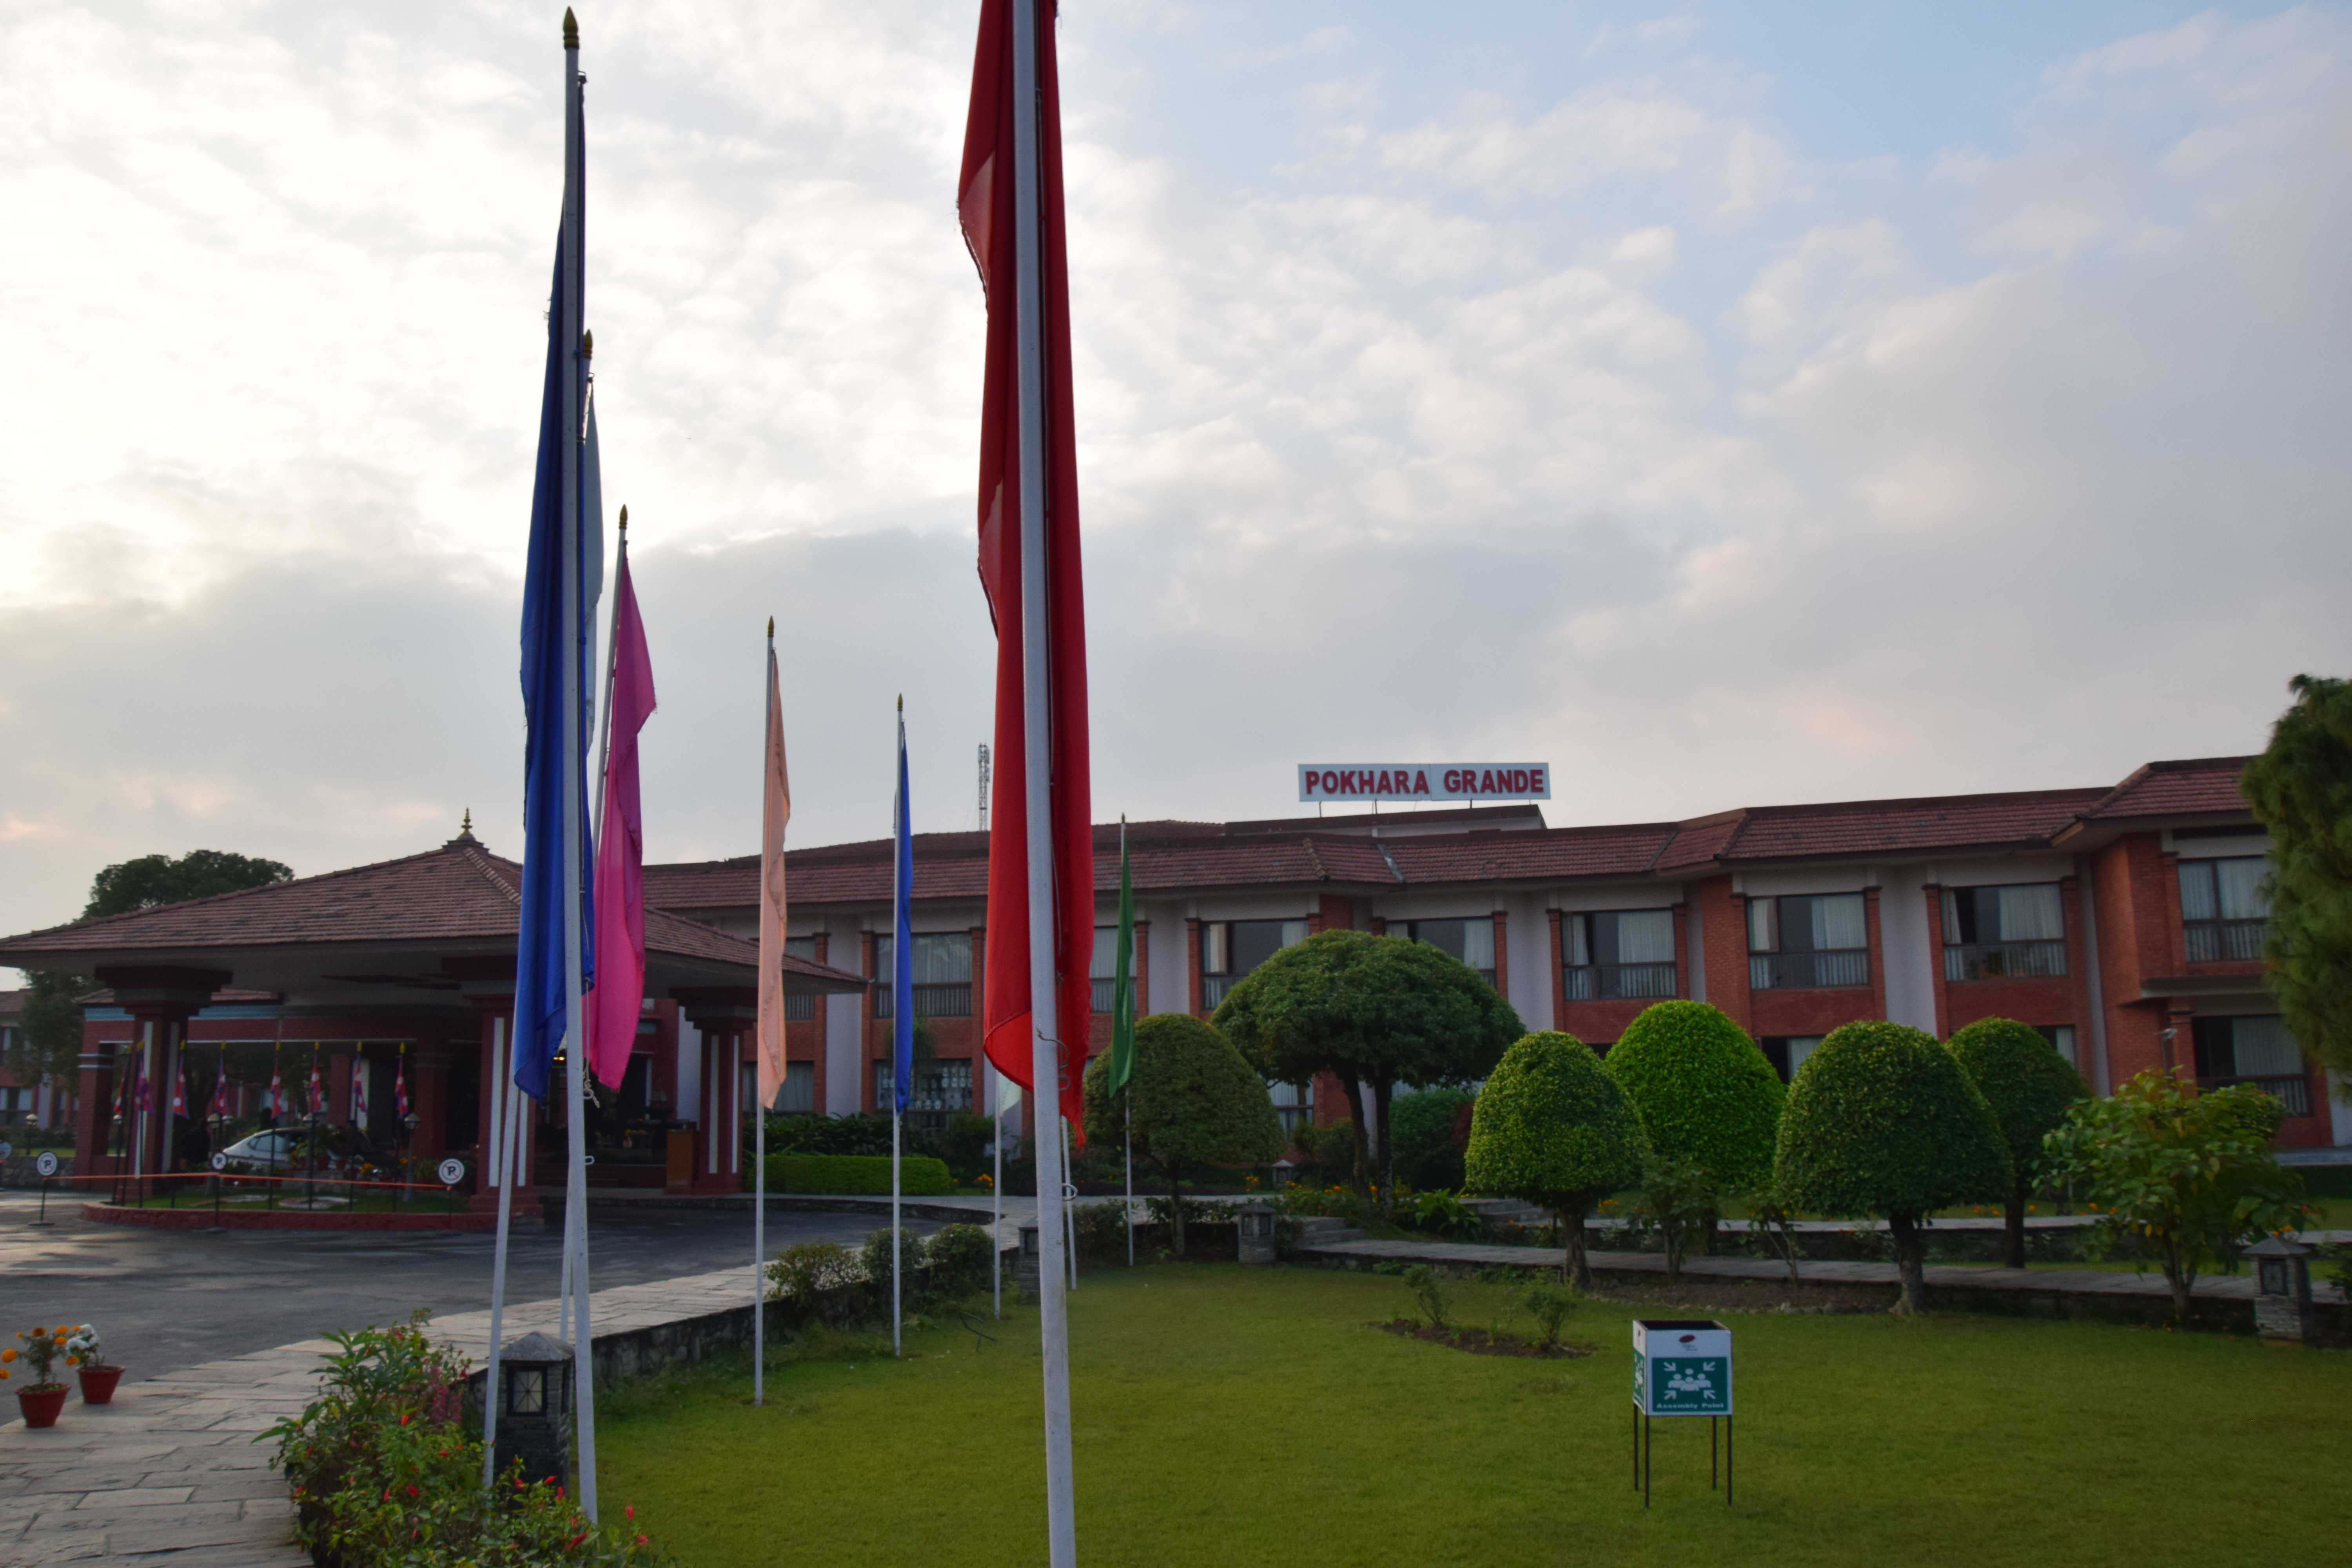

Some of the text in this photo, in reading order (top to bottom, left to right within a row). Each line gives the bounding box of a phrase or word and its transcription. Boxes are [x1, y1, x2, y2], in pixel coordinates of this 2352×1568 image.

[1305, 769, 1543, 795] POKHARA GRANDE
[44, 1160, 51, 1169] P
[448, 1166, 456, 1176] P
